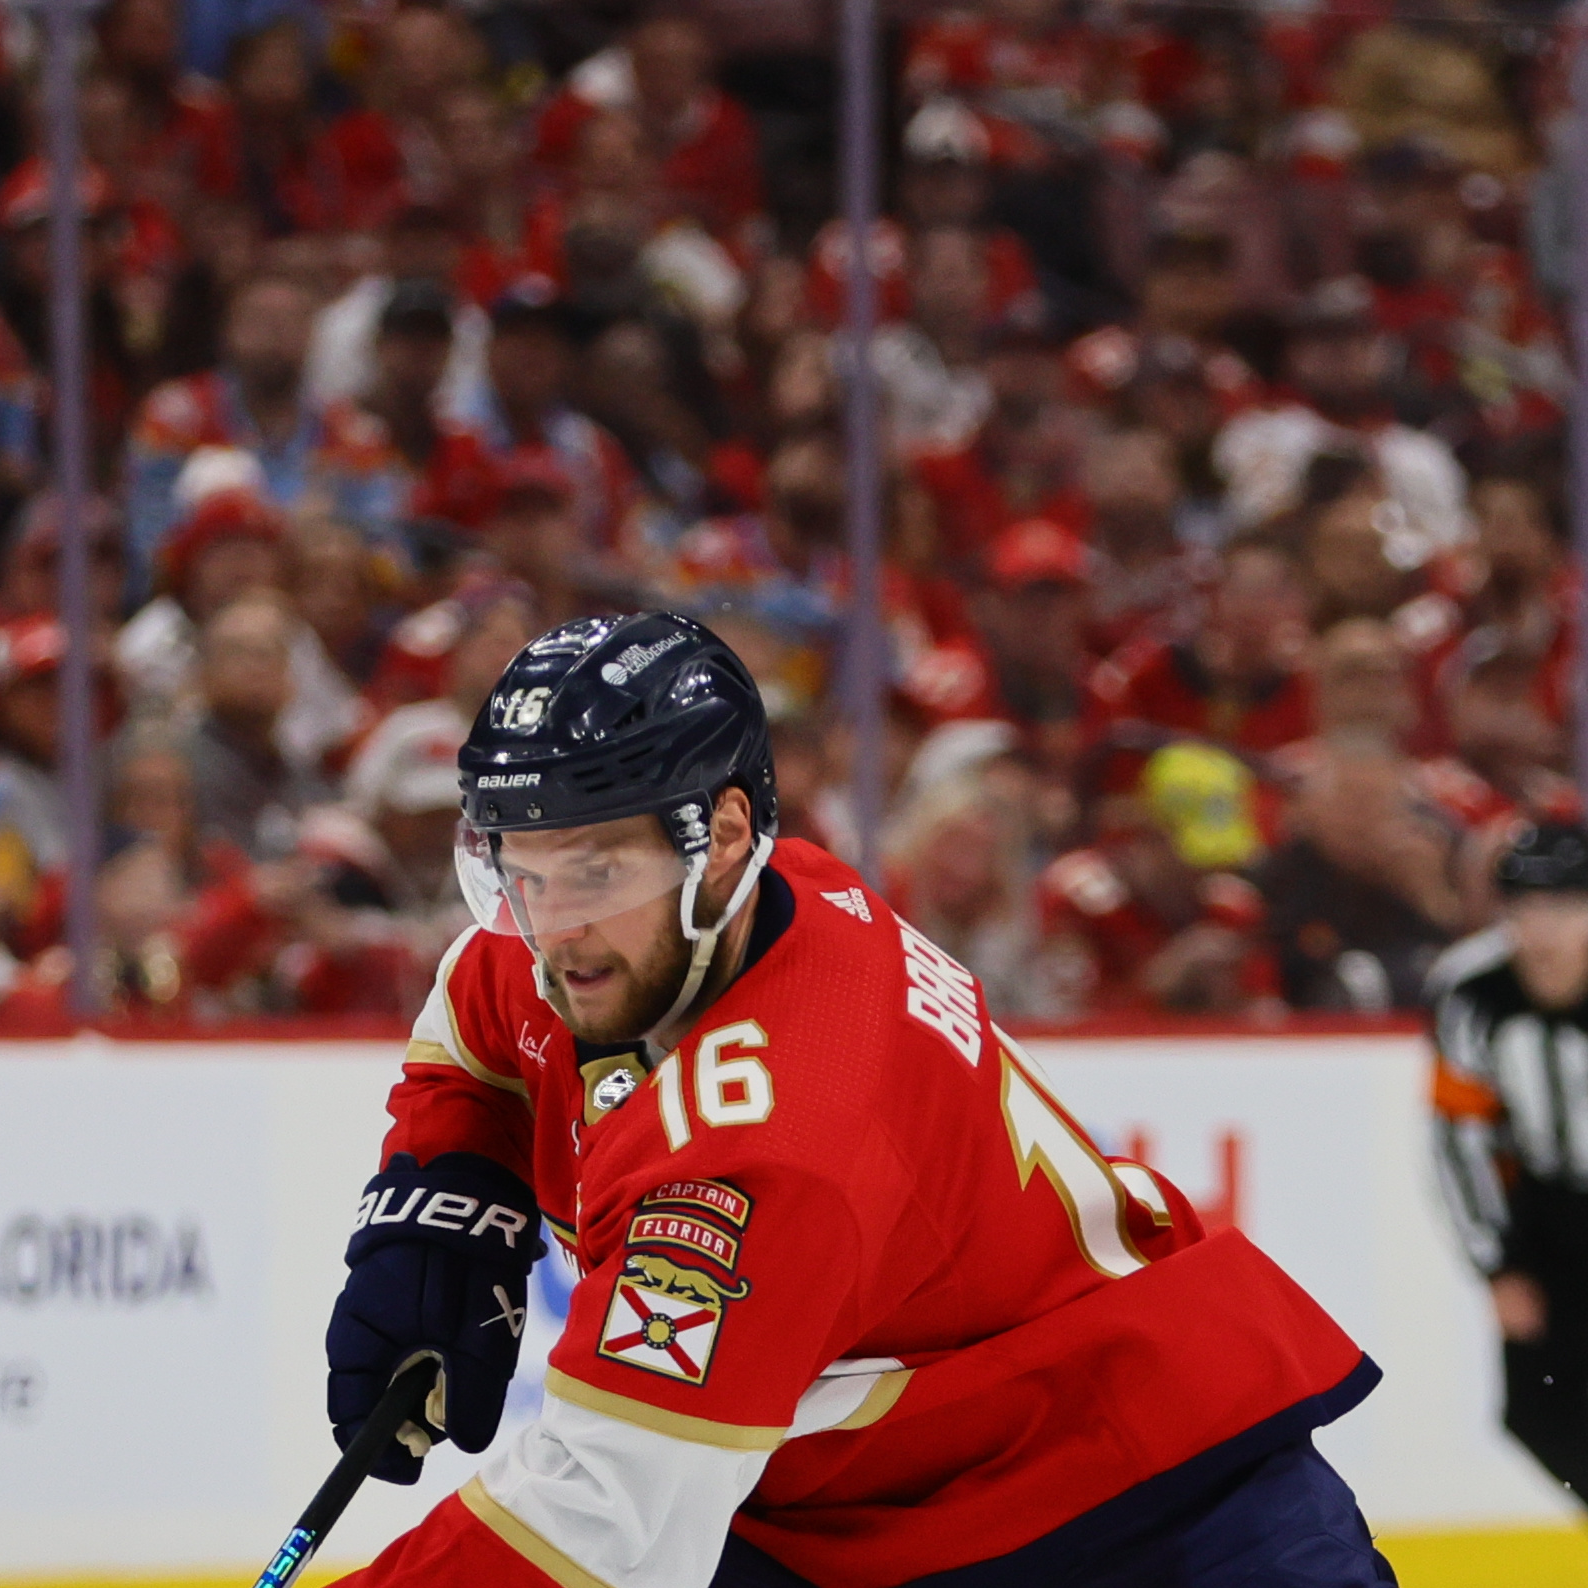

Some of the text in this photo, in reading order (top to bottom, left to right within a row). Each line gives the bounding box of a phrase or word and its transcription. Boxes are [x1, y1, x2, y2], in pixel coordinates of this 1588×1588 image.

[627, 631, 688, 673] LAUDERDALE
[501, 686, 552, 728] 16
[477, 773, 541, 789] BAUER
[849, 886, 873, 923] adidas
[890, 909, 982, 1068] BAR
[649, 1018, 775, 1153] 16
[352, 1186, 528, 1249] AUER
[656, 1182, 737, 1214] CAPTAIN
[642, 1220, 725, 1256] FLORIDA
